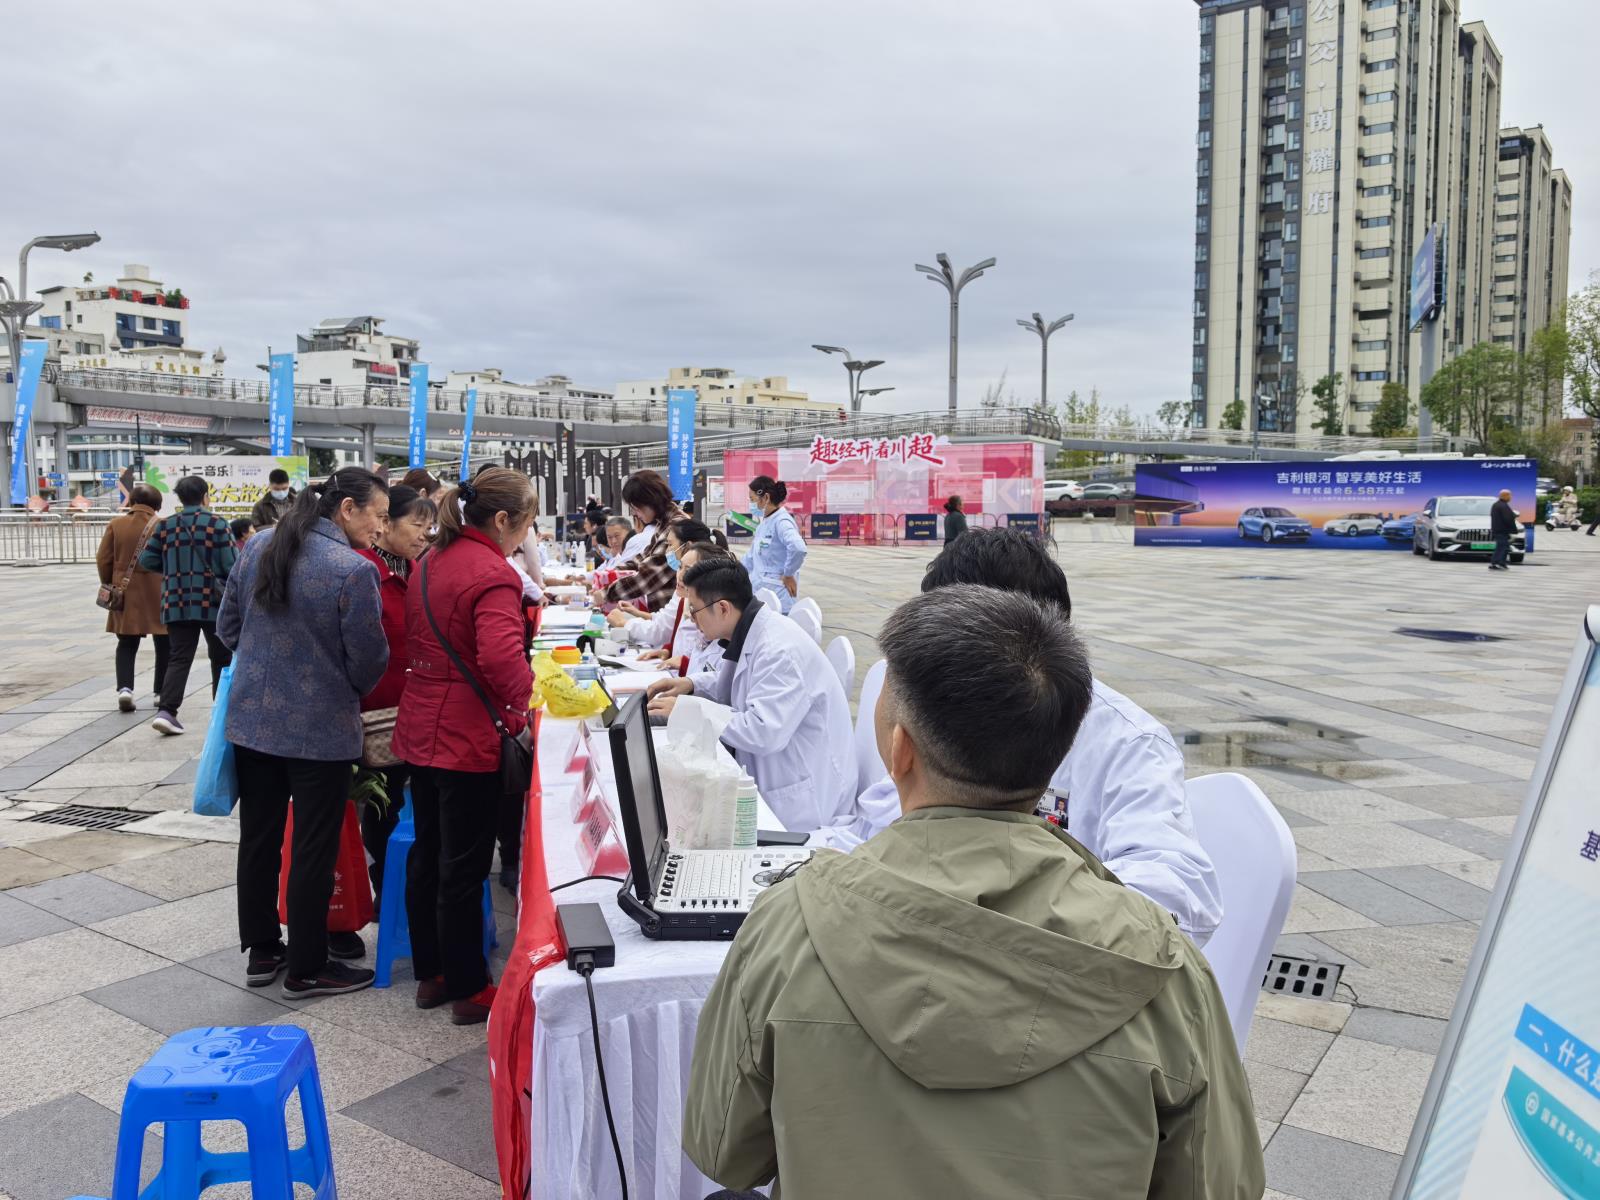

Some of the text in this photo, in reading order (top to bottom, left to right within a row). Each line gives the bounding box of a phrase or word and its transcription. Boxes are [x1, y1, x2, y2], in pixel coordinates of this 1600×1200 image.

[810, 434, 944, 465] 趣经开看川超
[179, 465, 229, 477] 十二音乐
[1276, 471, 1422, 484] 吉利银河 智享美好生活
